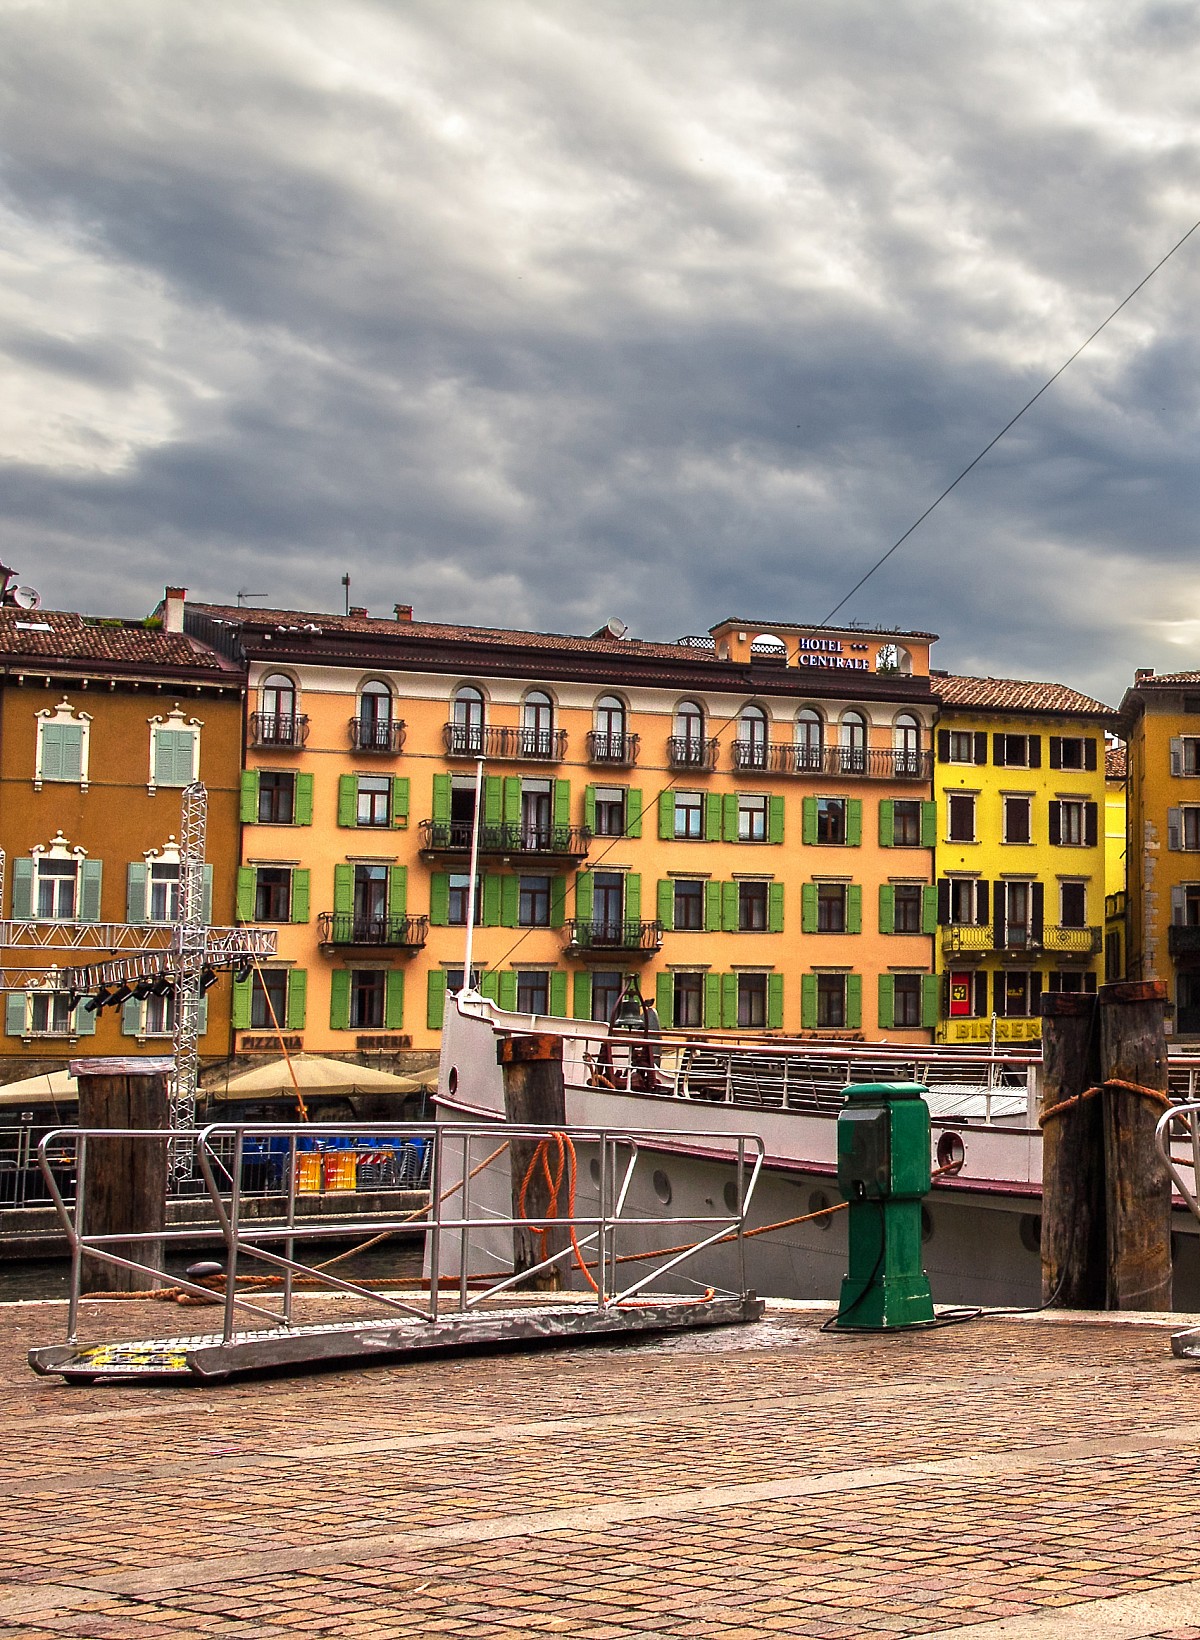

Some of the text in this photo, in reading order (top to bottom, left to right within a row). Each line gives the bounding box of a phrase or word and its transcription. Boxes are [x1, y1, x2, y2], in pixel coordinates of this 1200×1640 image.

[800, 638, 844, 652] HOTEL
[800, 654, 869, 670] CENTRALE
[243, 1036, 303, 1049] PIZZERIA
